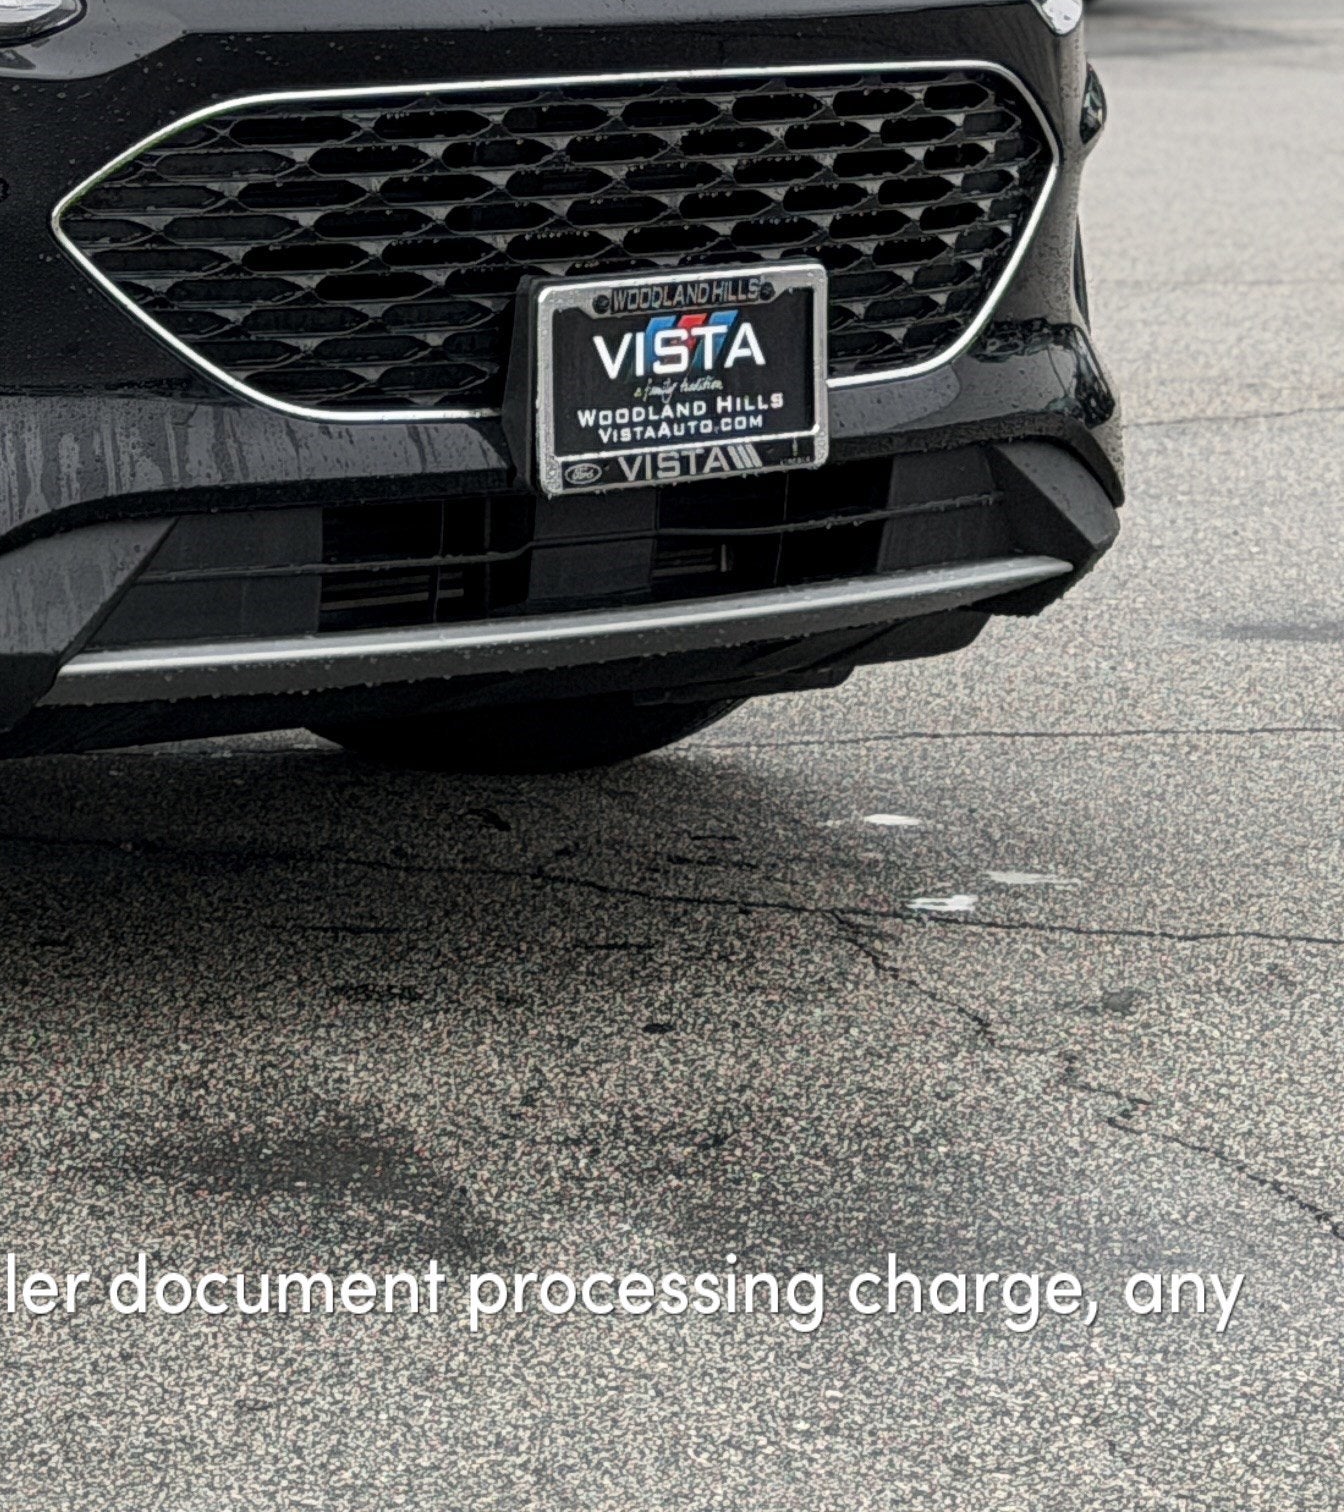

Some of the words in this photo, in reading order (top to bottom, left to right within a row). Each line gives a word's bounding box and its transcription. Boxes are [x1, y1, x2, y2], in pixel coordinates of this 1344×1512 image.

[613, 282, 709, 311] WOODLAND
[712, 277, 760, 303] HILLS
[592, 321, 766, 380] VISTA
[618, 446, 730, 481] VISTA
